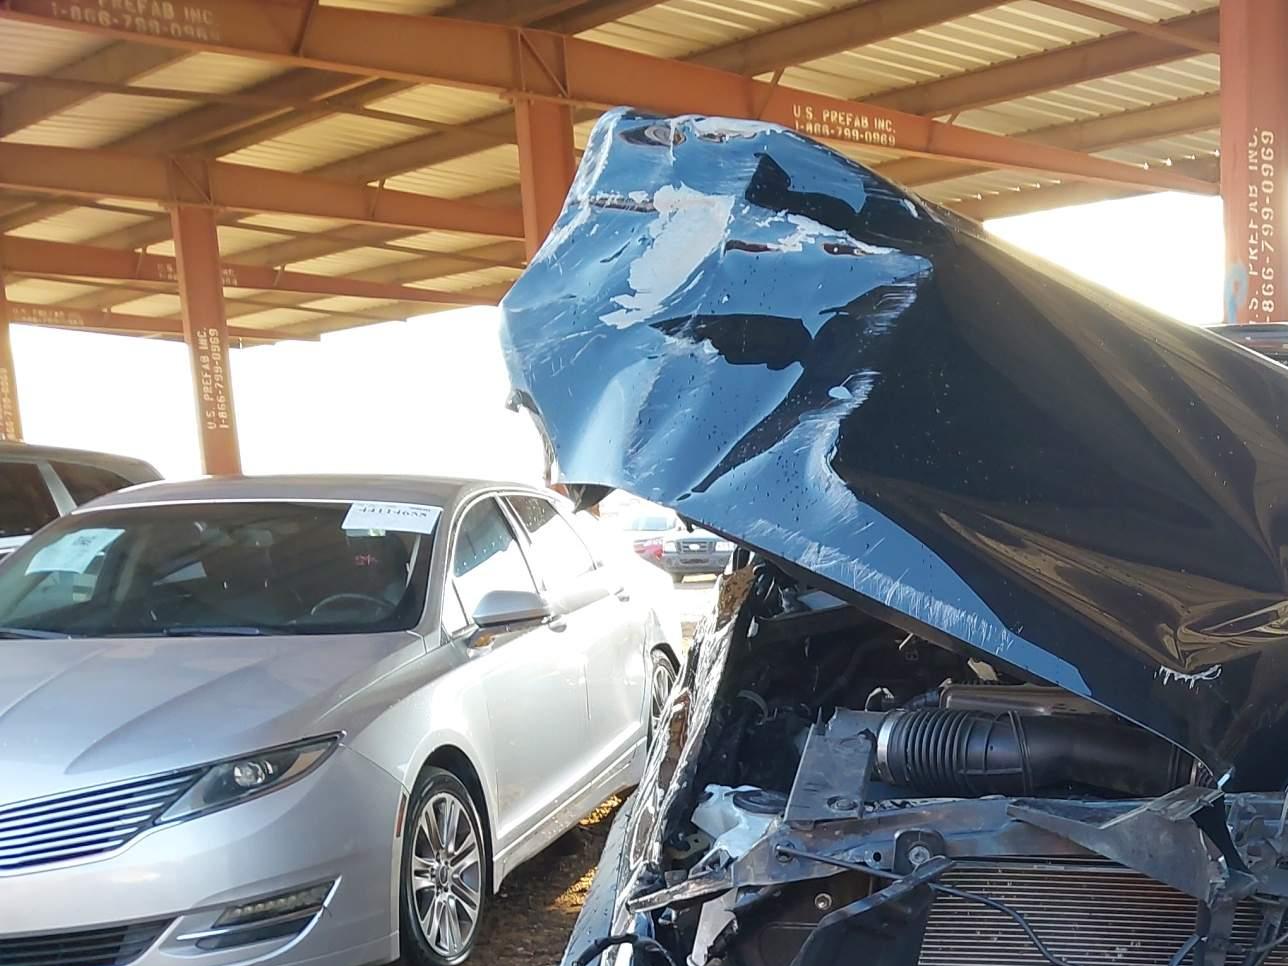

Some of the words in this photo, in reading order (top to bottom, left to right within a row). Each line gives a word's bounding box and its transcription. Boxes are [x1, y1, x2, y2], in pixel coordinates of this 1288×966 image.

[822, 109, 869, 129] PREFAB
[874, 117, 897, 134] INC.
[1248, 184, 1259, 276] PREFAB
[1261, 130, 1275, 323] -866-799-0969
[197, 327, 209, 351] INC.
[200, 355, 214, 402] PREFAB
[209, 328, 229, 429] 1-866-799-0969
